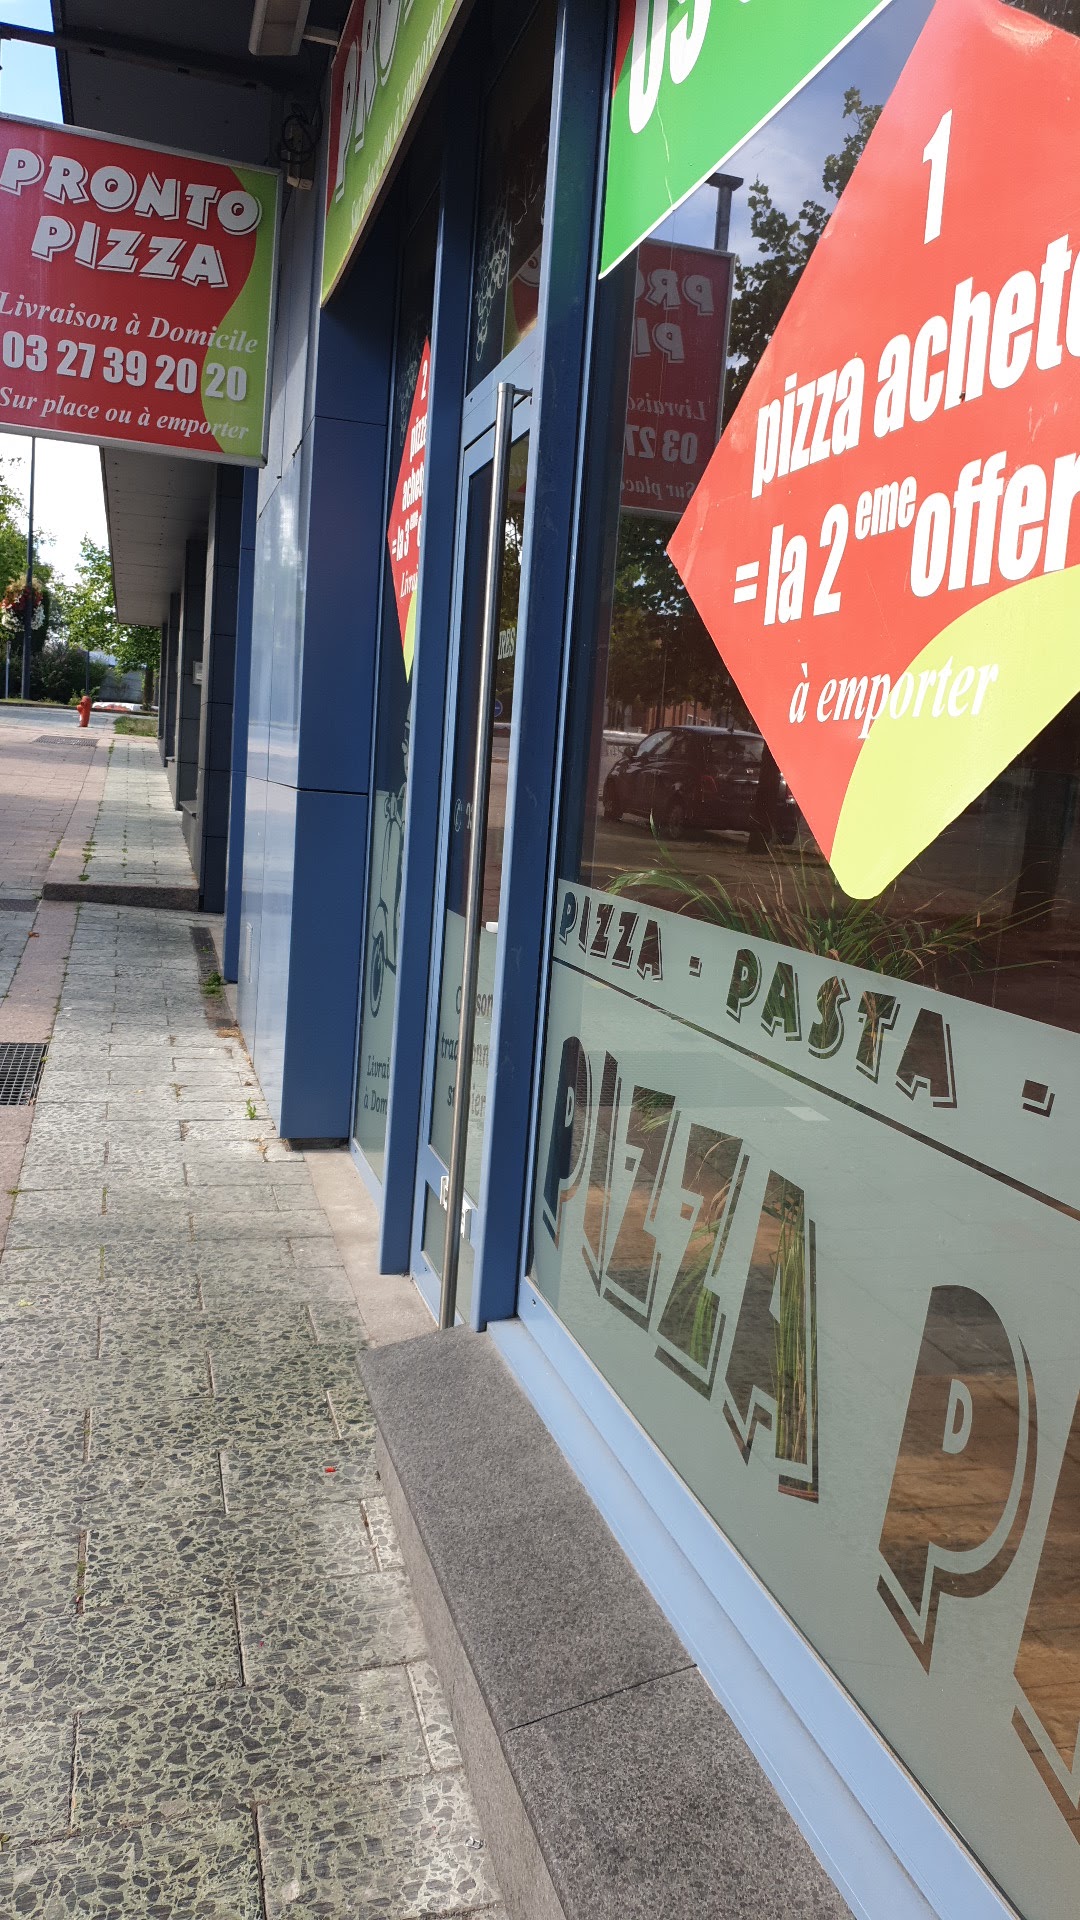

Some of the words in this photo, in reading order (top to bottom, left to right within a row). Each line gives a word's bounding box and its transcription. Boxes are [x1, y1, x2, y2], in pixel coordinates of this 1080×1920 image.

[0, 148, 263, 236] PRONTO
[922, 108, 952, 245] 1
[31, 215, 229, 289] PIZZA
[0, 290, 118, 333] Livraison
[125, 312, 143, 338] à
[147, 316, 259, 355] Domicile
[2, 330, 48, 373] 03
[56, 340, 96, 379] 27
[102, 347, 148, 387] 39
[154, 354, 198, 395] 20
[205, 362, 248, 402] 20
[752, 356, 865, 499] pizza
[873, 234, 1080, 439] achet
[0, 386, 38, 411] Sur
[40, 395, 100, 421] place
[105, 407, 133, 425] ou
[138, 405, 151, 427] à
[156, 413, 249, 440] emporter
[789, 662, 809, 725] à
[816, 655, 999, 740] emporter
[558, 891, 663, 981] PIZZA
[726, 948, 958, 1109] PASTA
[543, 1036, 820, 1504] PIZZA
